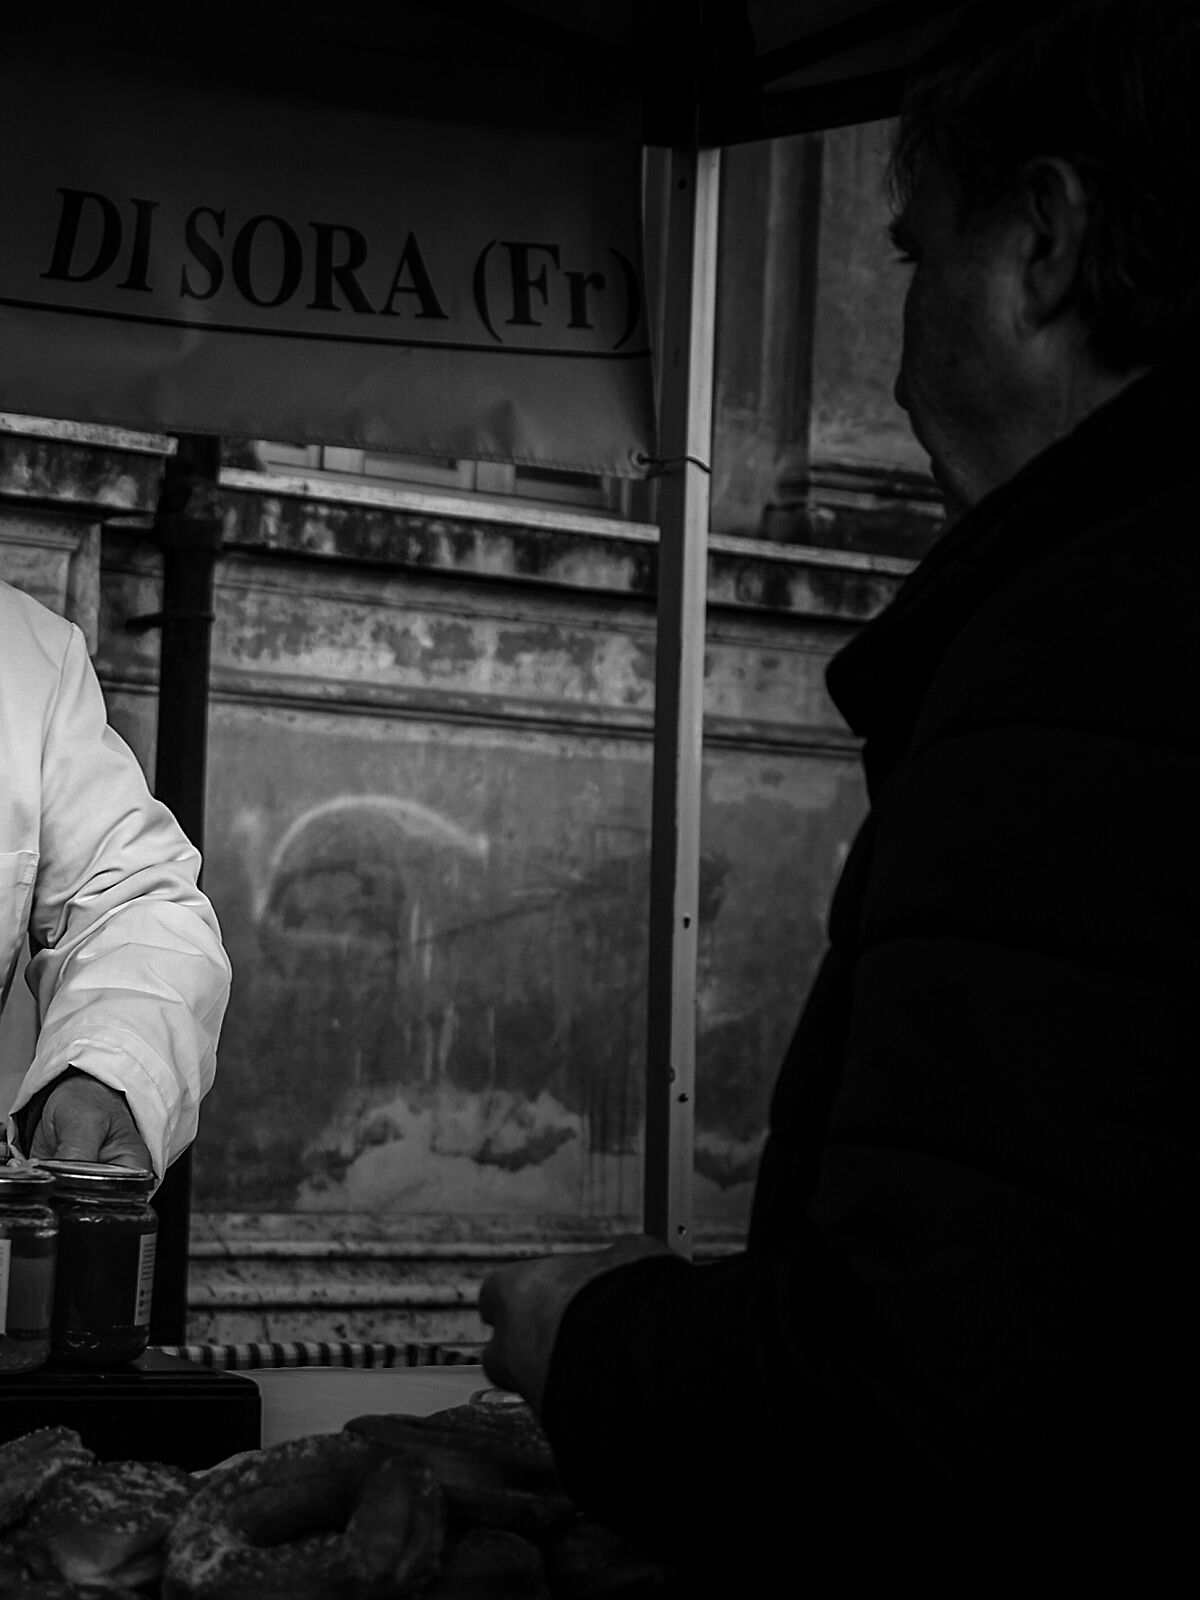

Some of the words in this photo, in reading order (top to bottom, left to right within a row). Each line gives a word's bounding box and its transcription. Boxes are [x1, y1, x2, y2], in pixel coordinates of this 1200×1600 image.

[39, 187, 160, 292] DI
[180, 206, 449, 320] SORA
[473, 239, 641, 350] (Fr)
